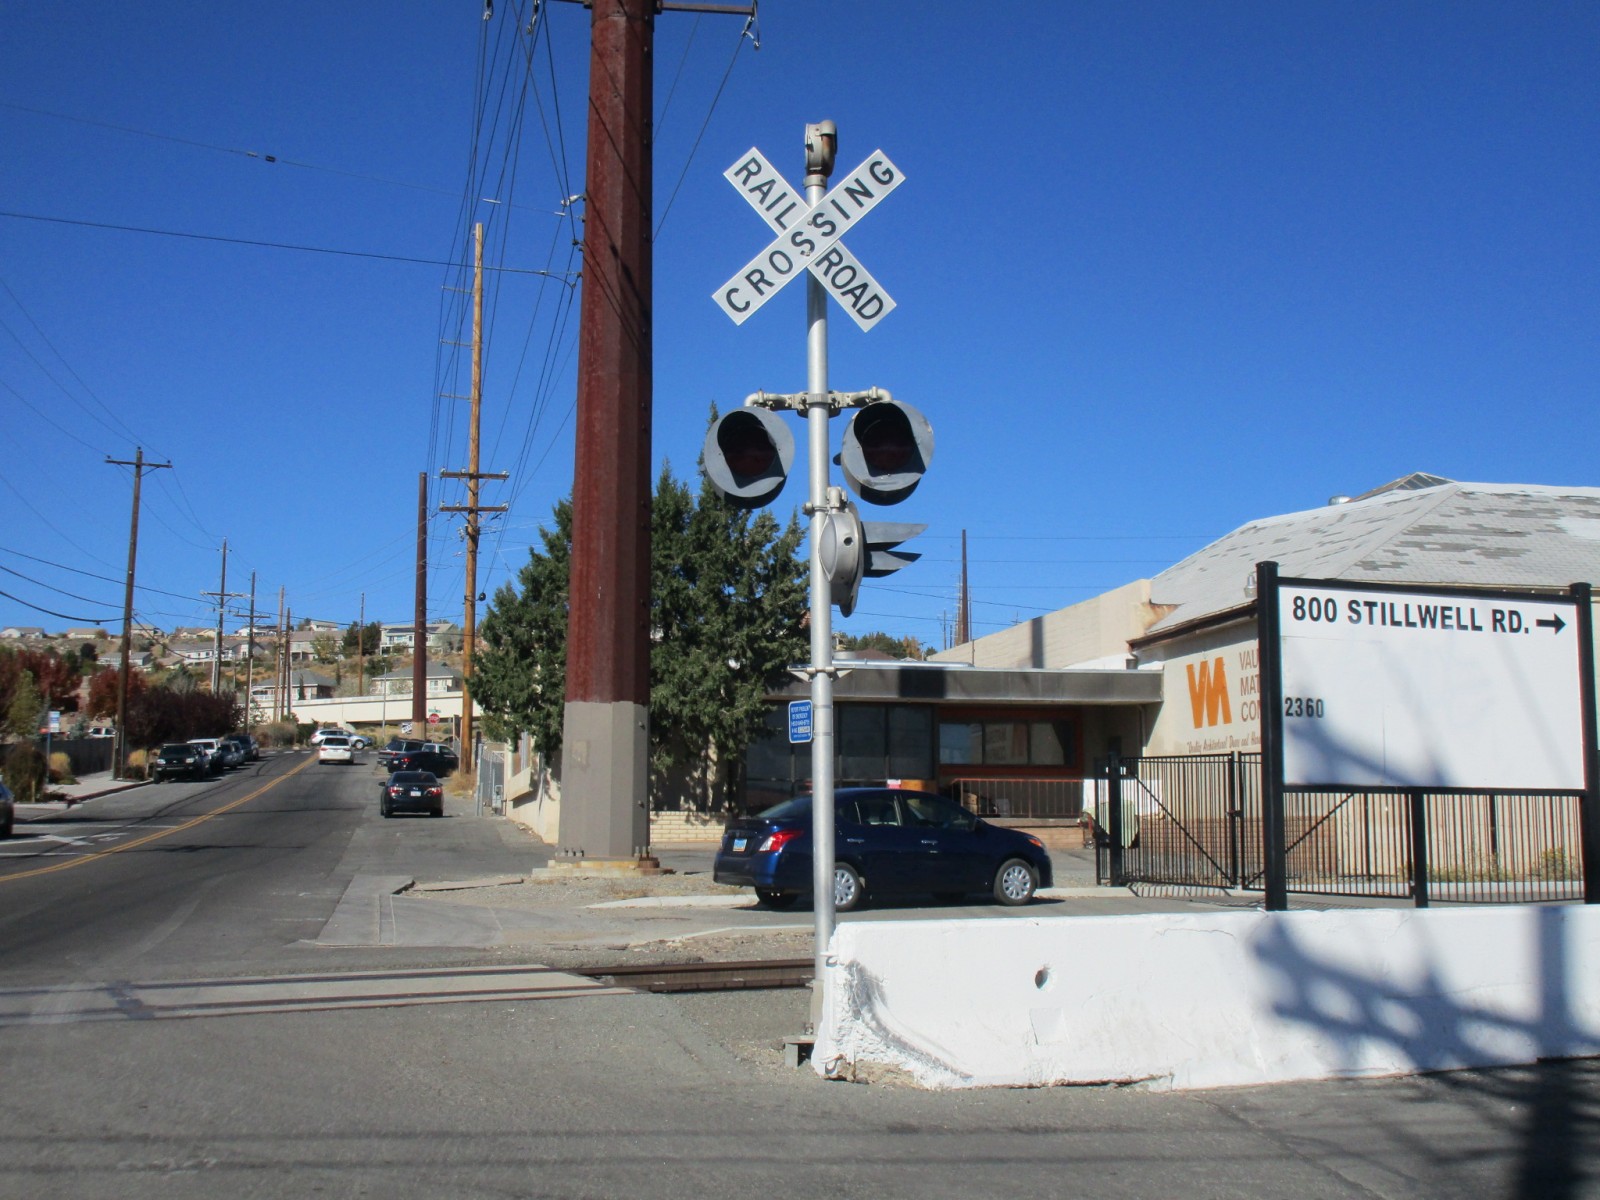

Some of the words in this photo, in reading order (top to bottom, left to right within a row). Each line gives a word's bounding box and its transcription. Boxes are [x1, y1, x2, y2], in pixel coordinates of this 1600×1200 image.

[725, 160, 895, 313] CROSSING
[734, 157, 797, 230] RAIL
[815, 247, 884, 320] ROAD
[1292, 596, 1338, 623] 800
[1347, 599, 1483, 631] STILLWELL
[1491, 608, 1529, 634] RD.
[1284, 696, 1325, 719] 2360
